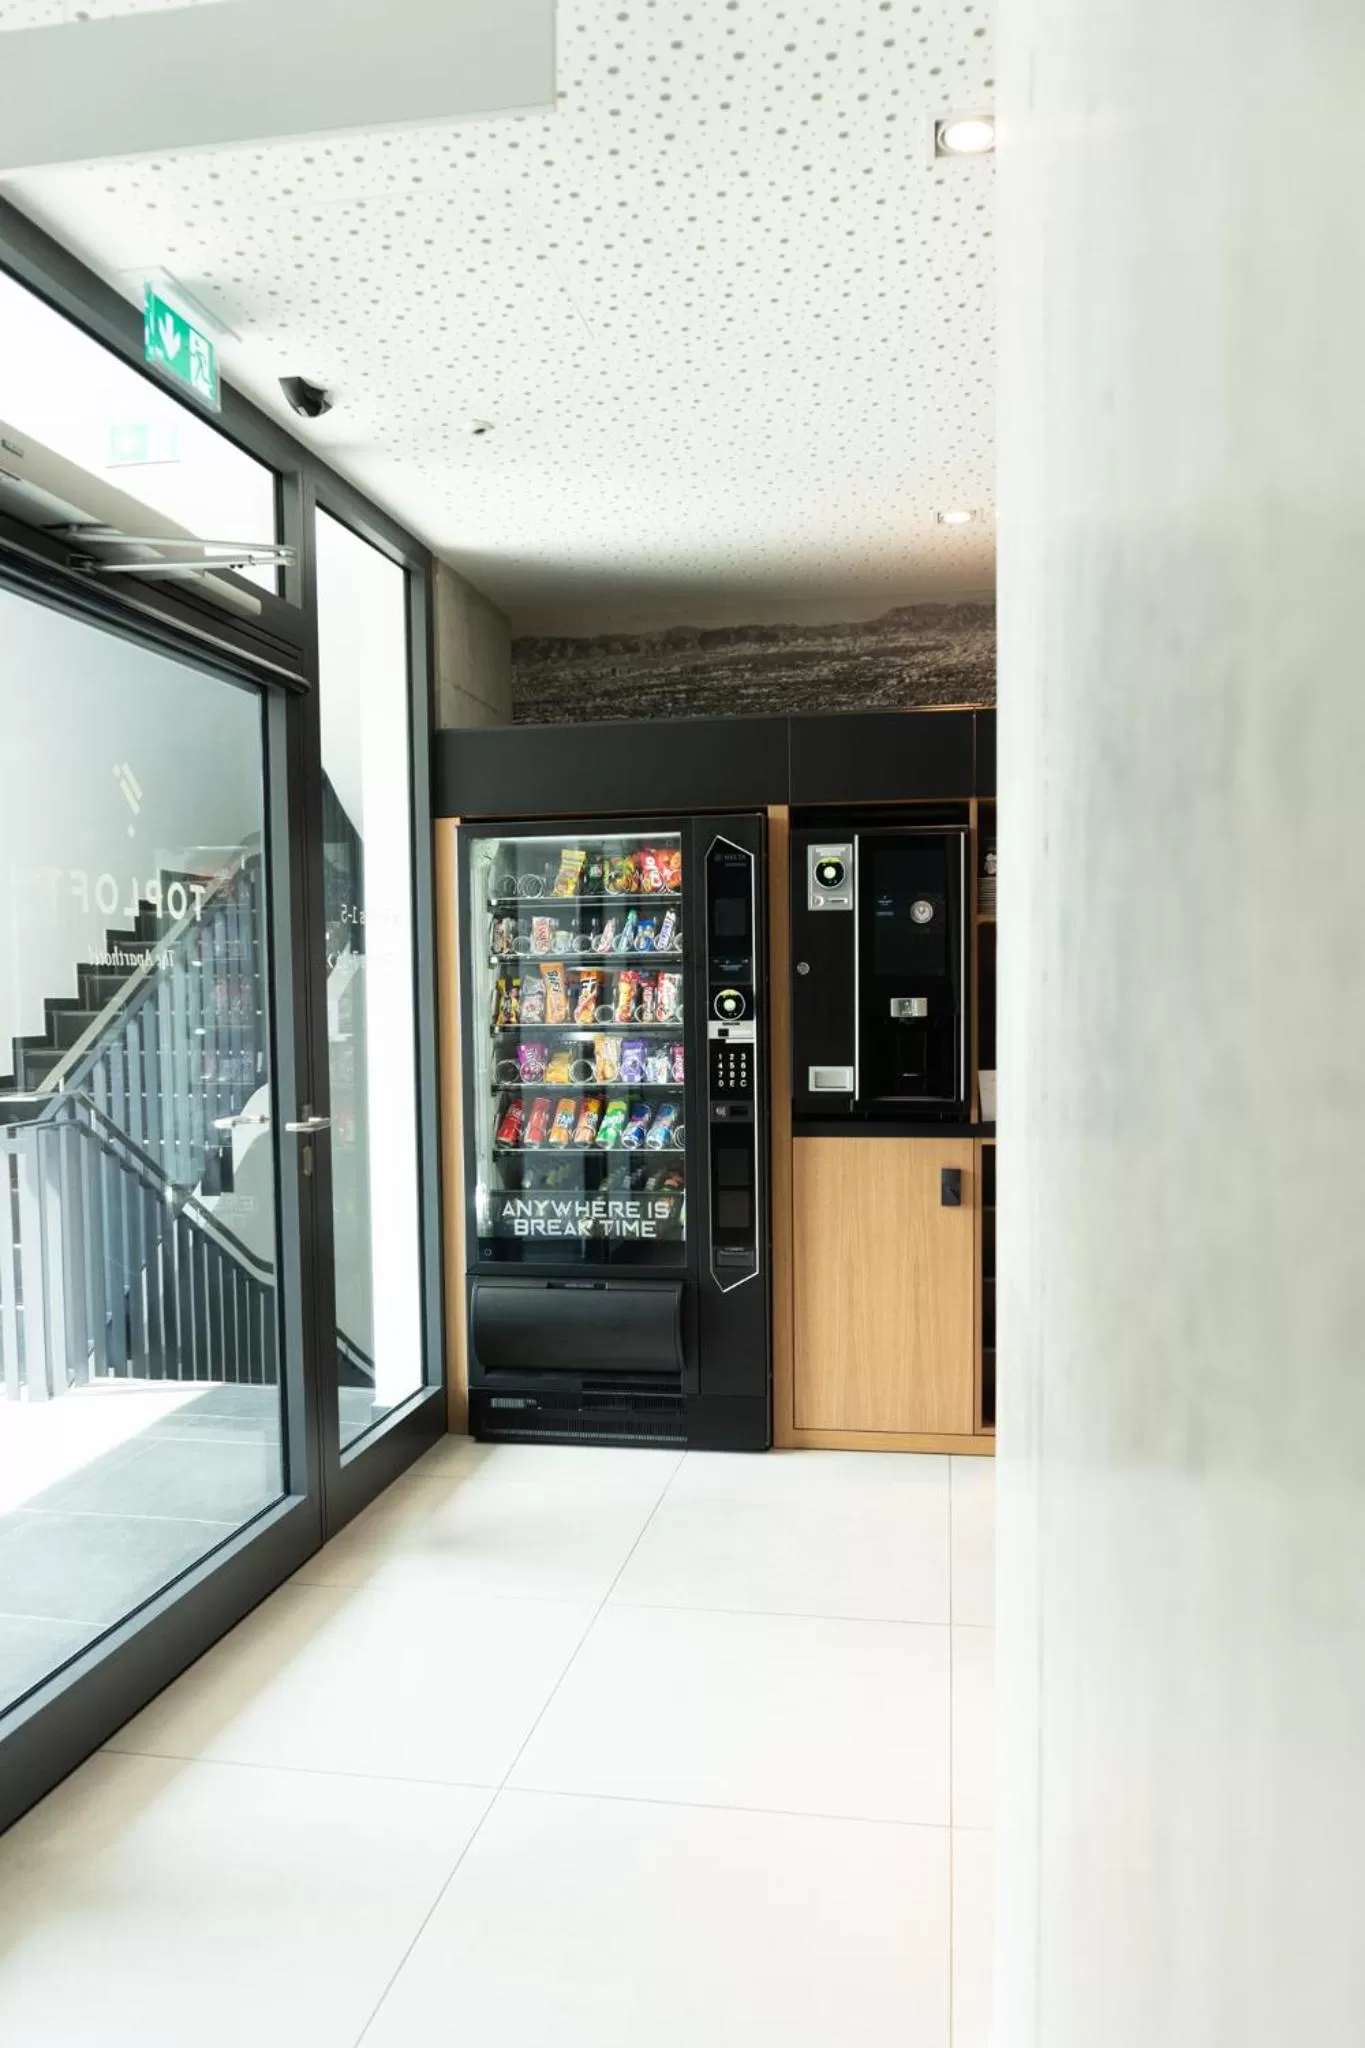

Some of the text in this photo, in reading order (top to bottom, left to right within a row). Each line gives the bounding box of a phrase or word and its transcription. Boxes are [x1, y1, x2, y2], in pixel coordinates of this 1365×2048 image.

[740, 1079, 747, 1087] C
[502, 1198, 670, 1219] ANYWHERE IS
[514, 1218, 657, 1238] BREAK TIME
